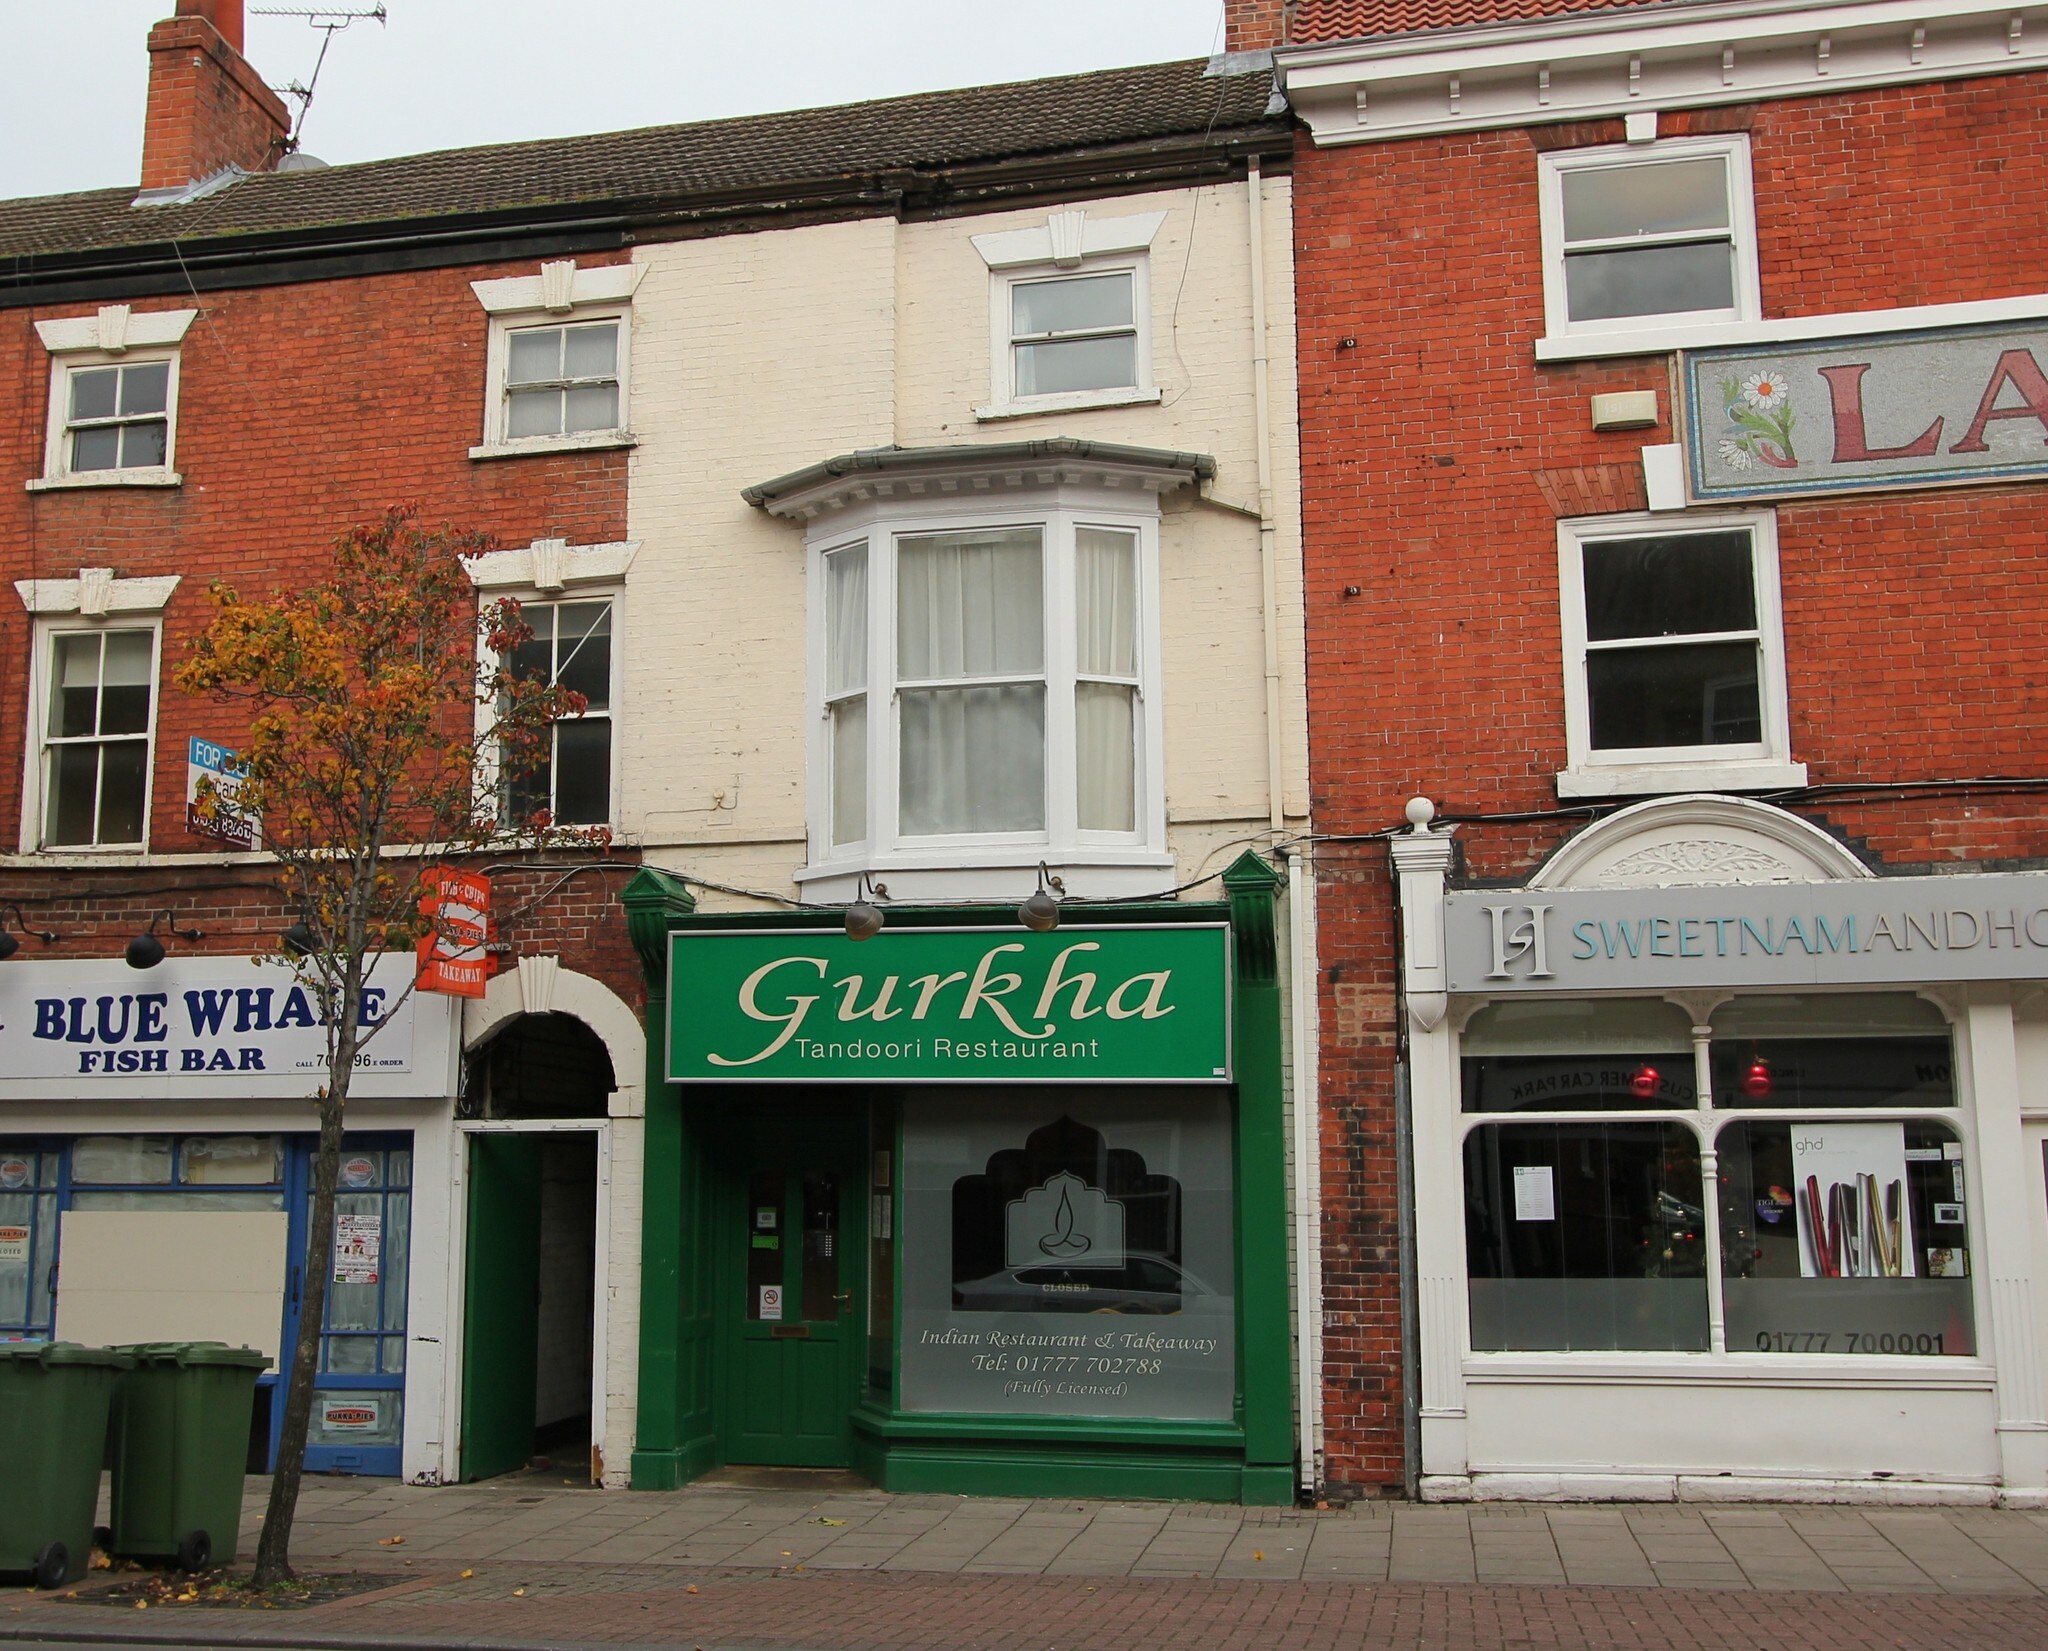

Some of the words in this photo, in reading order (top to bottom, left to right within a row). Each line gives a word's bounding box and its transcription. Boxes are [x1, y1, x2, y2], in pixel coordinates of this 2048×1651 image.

[196, 742, 220, 767] FOR
[438, 961, 481, 983] TAKEAWAY
[707, 942, 1175, 1066] Gurkha
[33, 993, 168, 1044] BLUE
[795, 1038, 921, 1059] Tandoori
[934, 1038, 1099, 1059] Restaurant
[78, 1050, 168, 1073] FISH
[180, 1048, 266, 1072] BAR
[317, 1054, 371, 1067] 7096
[1795, 1137, 1824, 1156] ghd
[1042, 1284, 1090, 1292] CLOSED
[920, 1329, 980, 1345] Indian
[986, 1330, 1088, 1348] Restaurant
[1094, 1332, 1116, 1349] &
[1120, 1332, 1217, 1356] Takeaway
[1756, 1331, 1832, 1352] 01777
[1845, 1333, 1944, 1355] 700001
[971, 1353, 1008, 1372] Tel:
[1016, 1355, 1079, 1372] 01777
[1086, 1357, 1162, 1375] 702788
[1004, 1379, 1051, 1398] (Fully
[1056, 1381, 1129, 1397] Licensed)
